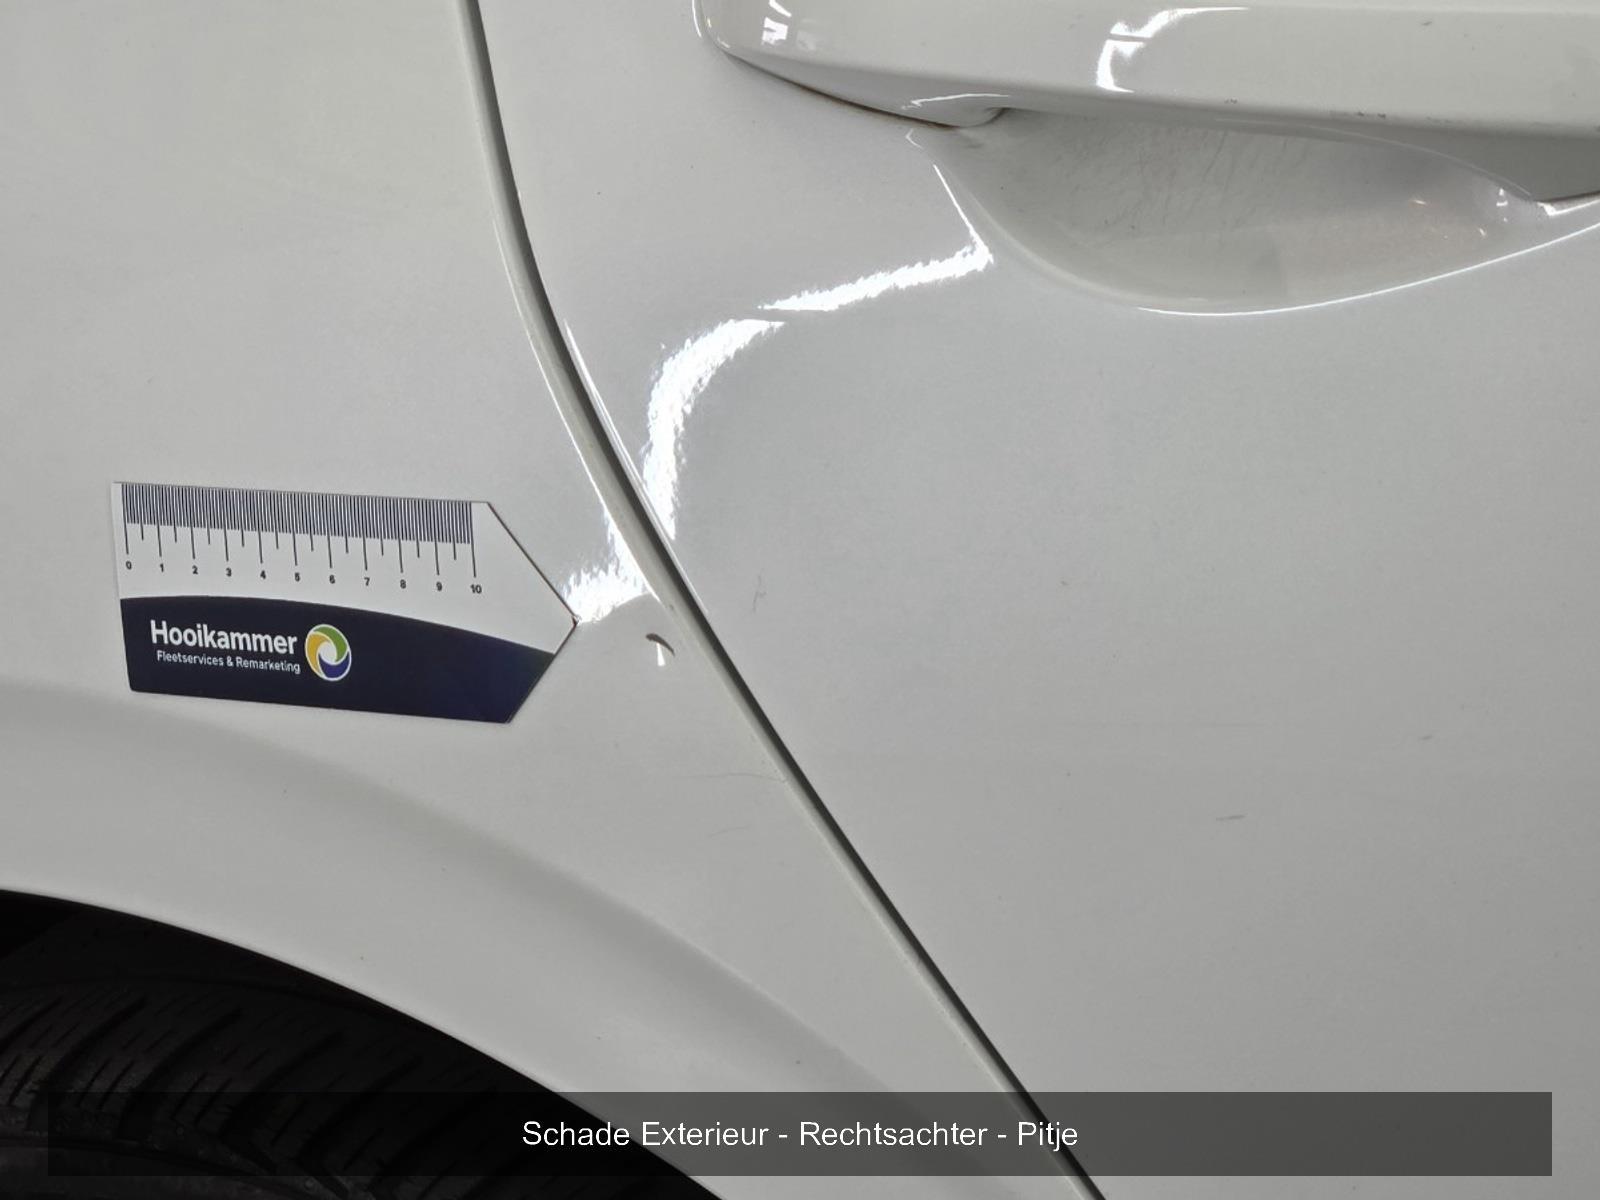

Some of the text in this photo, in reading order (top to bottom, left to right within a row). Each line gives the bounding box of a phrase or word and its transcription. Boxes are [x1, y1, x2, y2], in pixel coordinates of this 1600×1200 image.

[126, 561, 483, 594] 0 1 2 3 4 5 6 7 8 9 10
[150, 619, 298, 655] Hooikammer
[157, 650, 301, 675] Fleetservices & Remarketing
